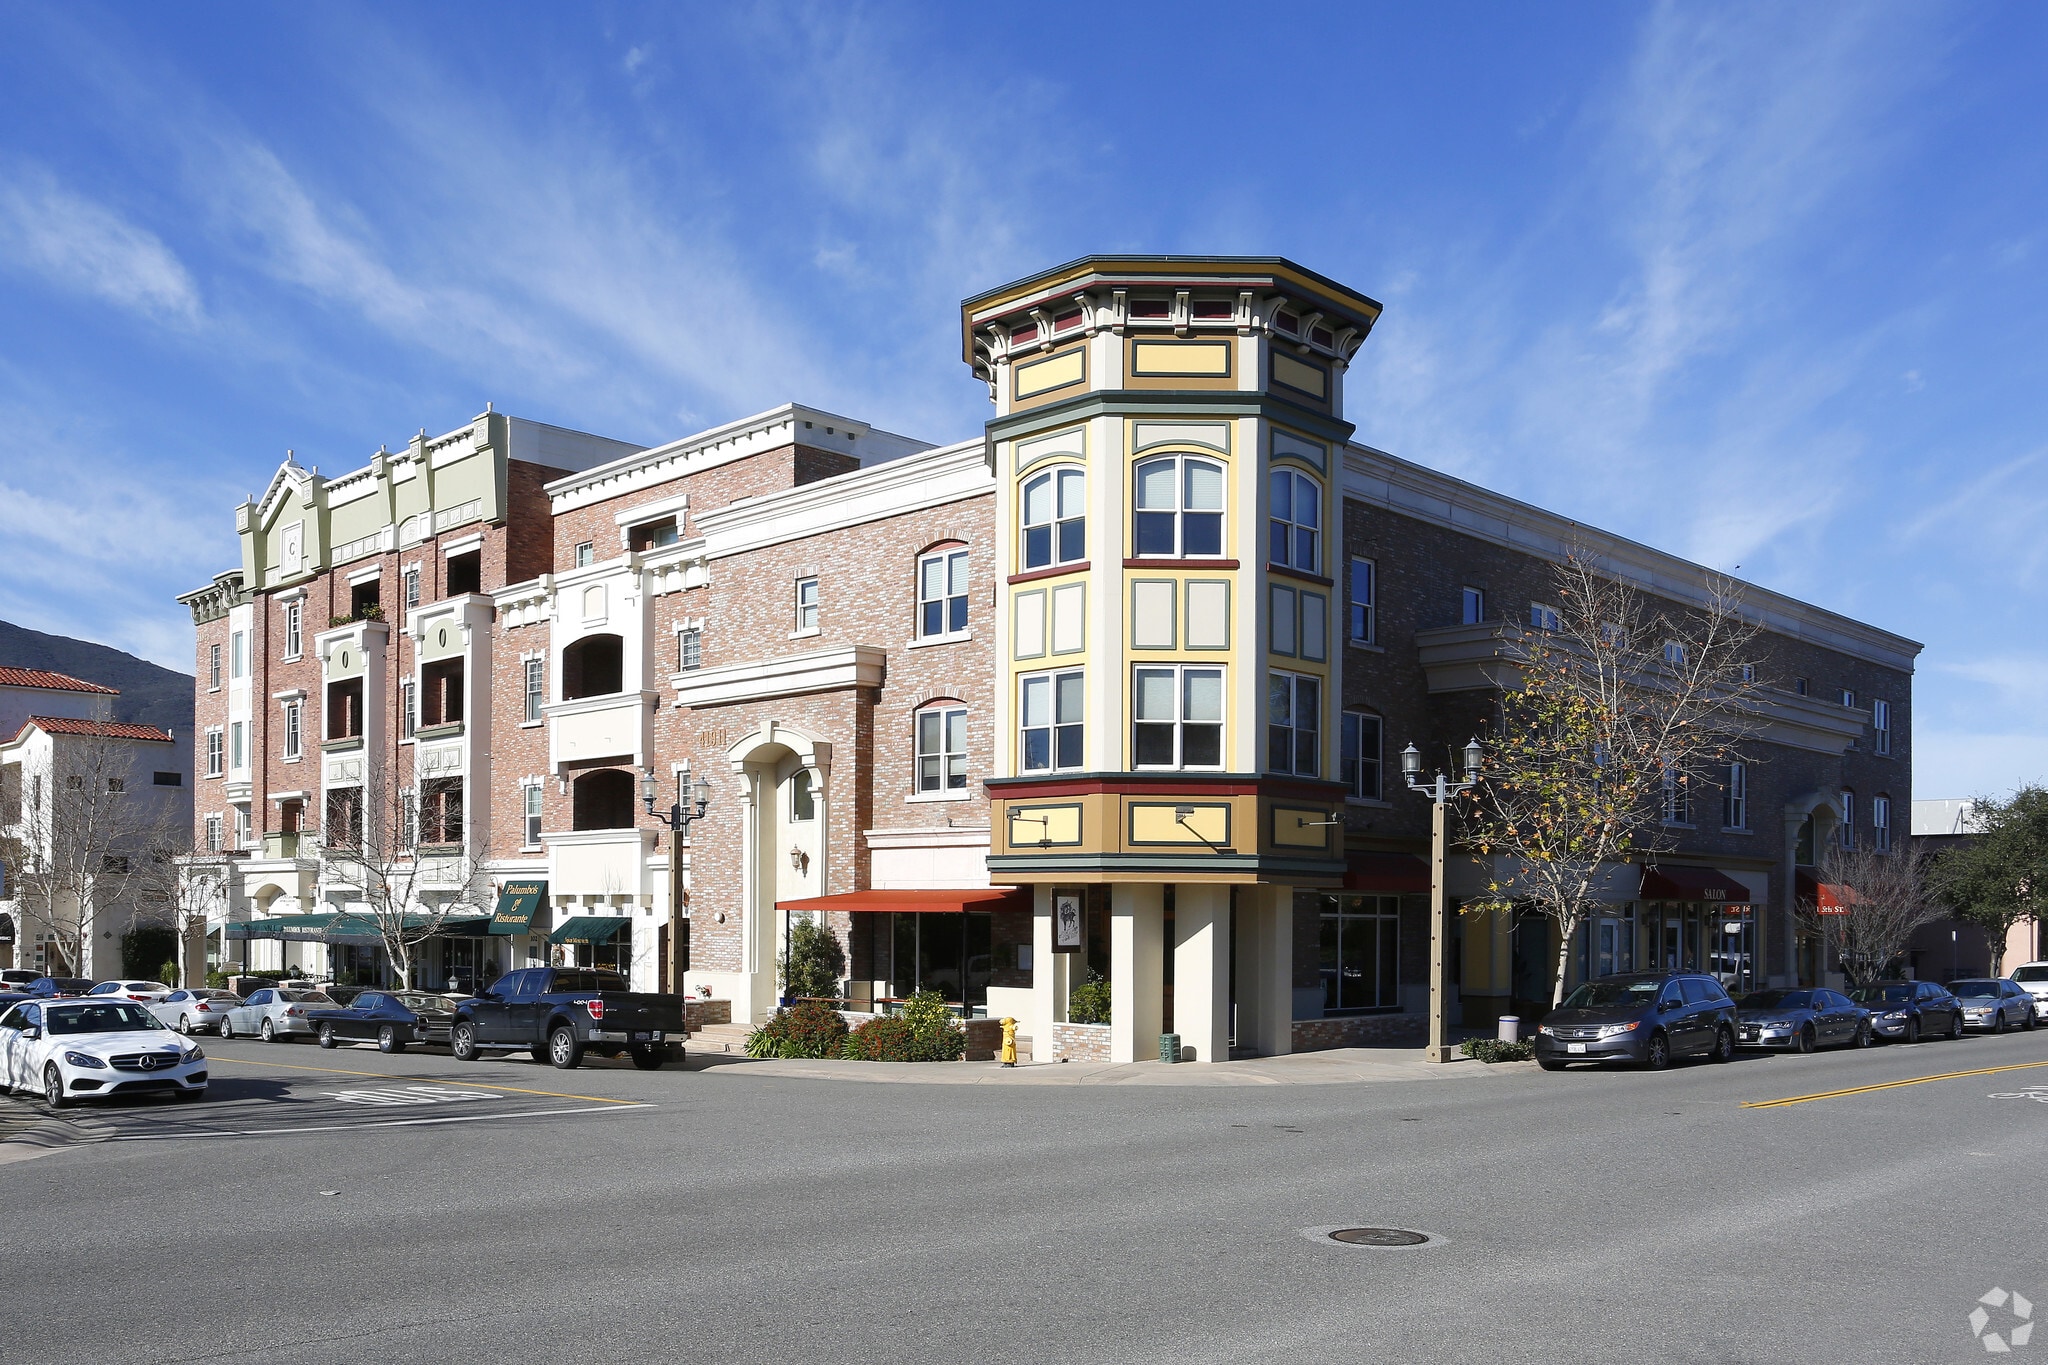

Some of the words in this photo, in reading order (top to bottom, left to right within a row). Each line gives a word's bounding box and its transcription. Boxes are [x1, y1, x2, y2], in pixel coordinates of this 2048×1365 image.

[699, 730, 727, 747] 41911
[506, 884, 538, 894] Palumbo's
[1704, 888, 1726, 900] SALON
[495, 913, 528, 923] Ristorante
